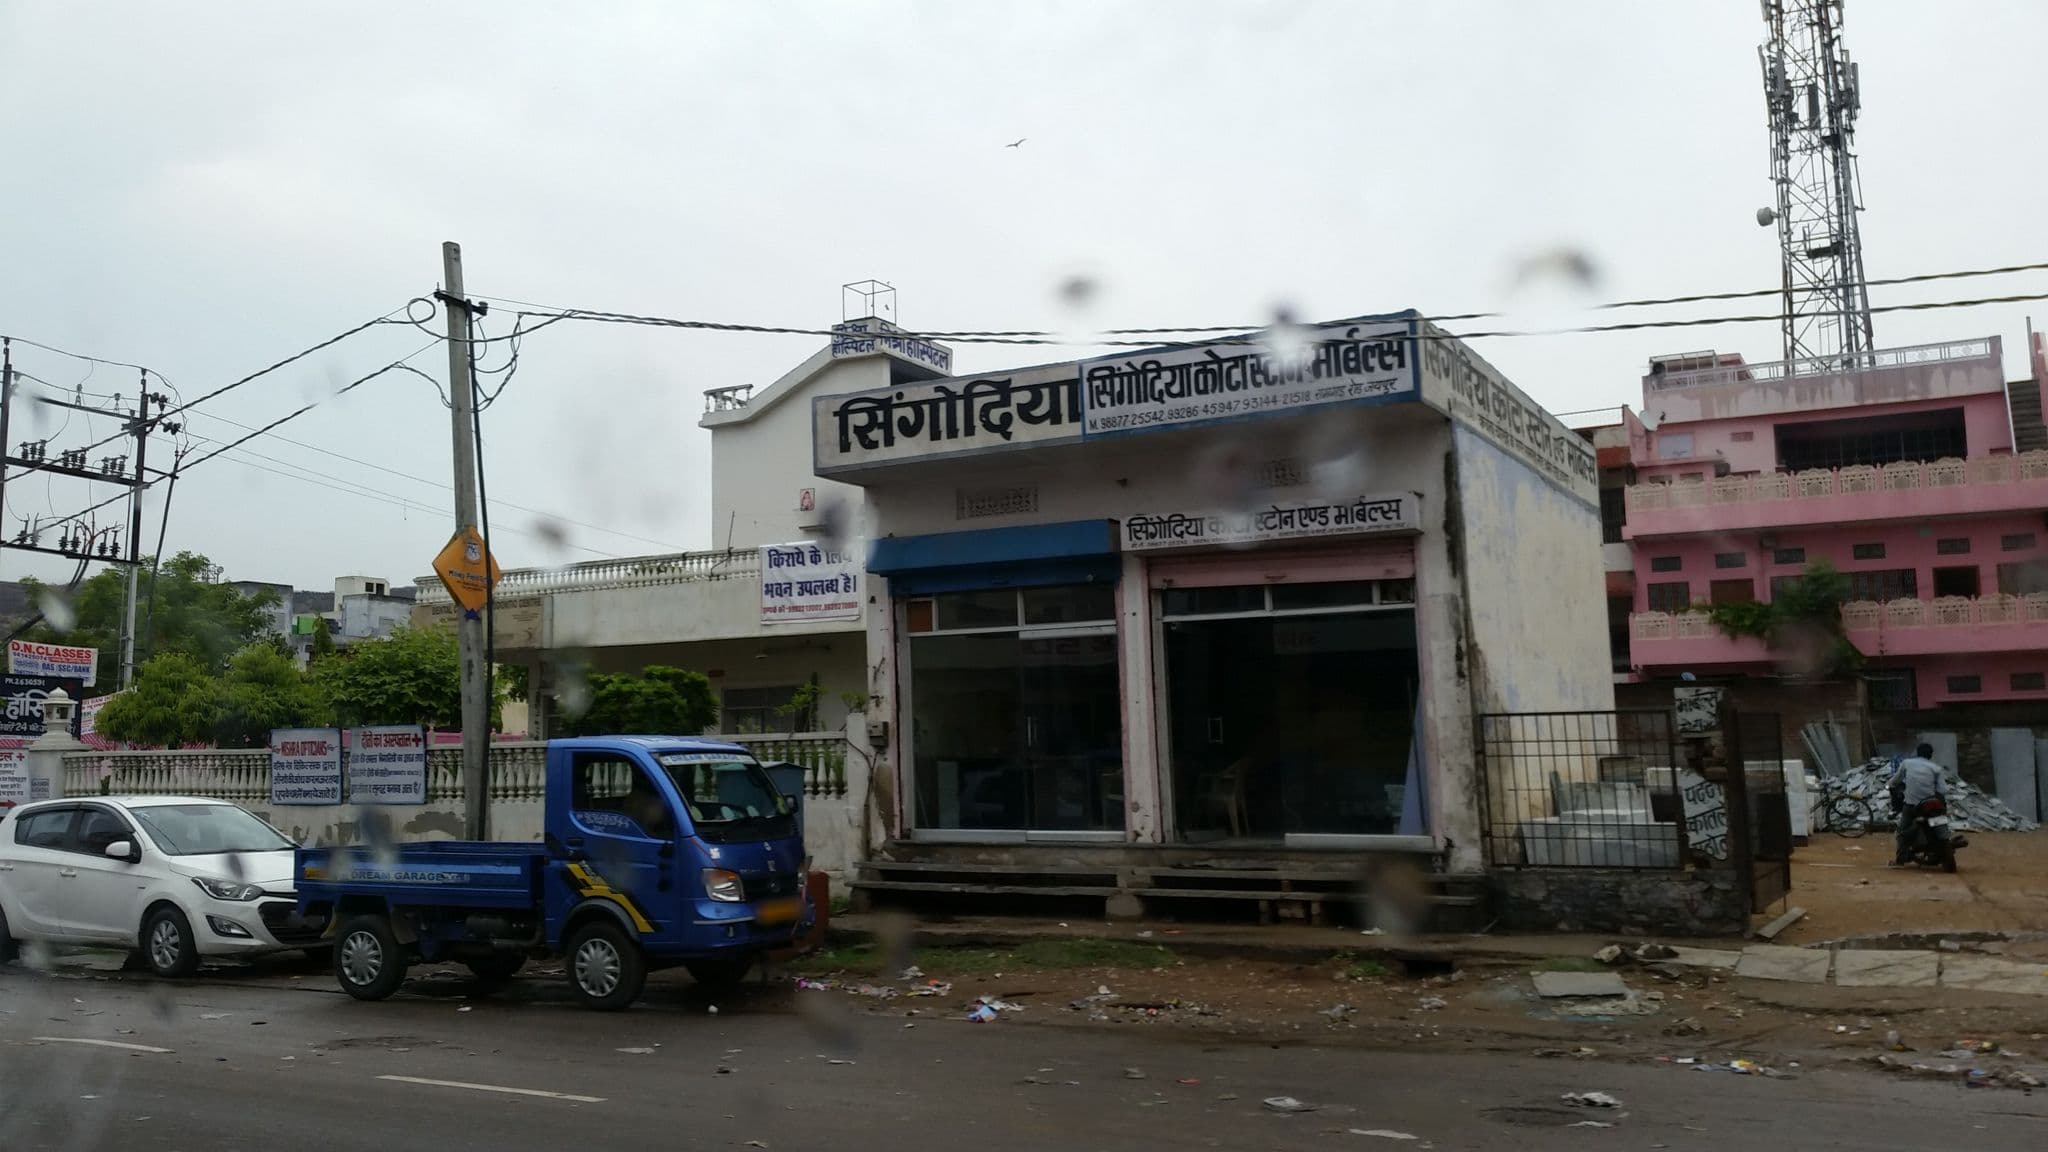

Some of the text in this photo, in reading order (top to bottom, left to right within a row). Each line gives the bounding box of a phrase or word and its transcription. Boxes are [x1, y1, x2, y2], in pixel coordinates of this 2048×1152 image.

[1087, 360, 1193, 411] सिंगोदिया
[1194, 349, 1248, 397] कोटा
[833, 378, 1081, 454] सिंगोदिया
[1127, 514, 1204, 542] सिंगोदिया
[1255, 505, 1294, 530] स्टोन
[1333, 495, 1402, 525] मार्बल्स
[768, 547, 806, 568] किराये
[808, 545, 822, 566] के
[764, 580, 793, 598] भवन
[797, 578, 839, 597] उपलब्ध
